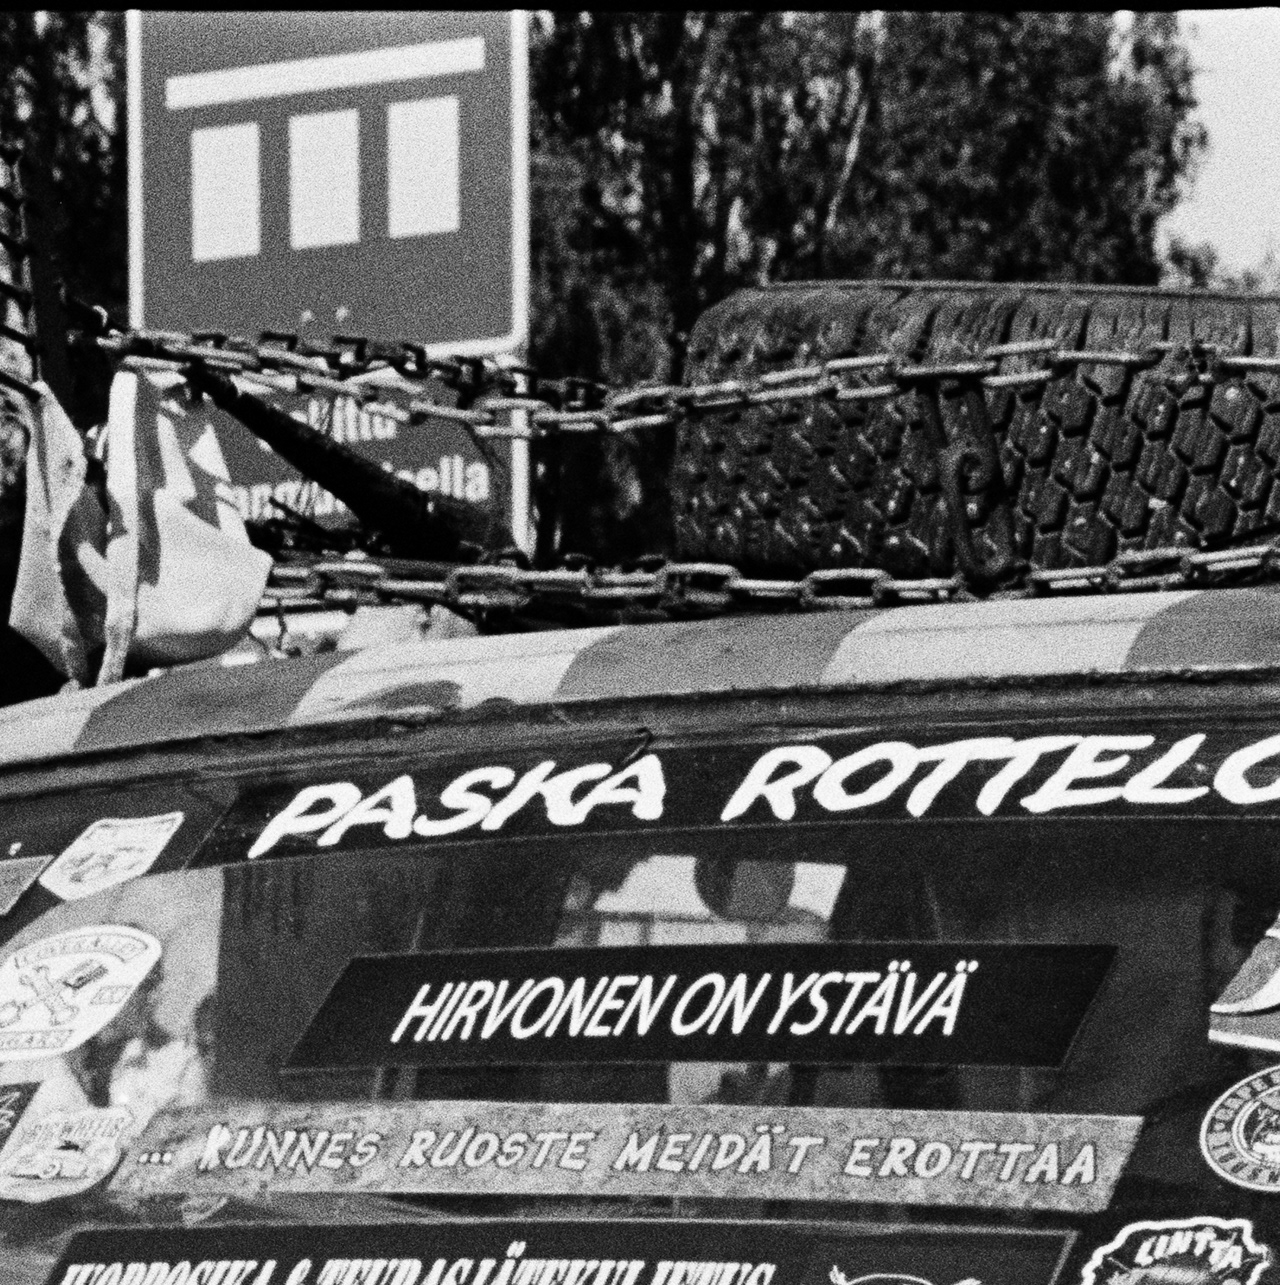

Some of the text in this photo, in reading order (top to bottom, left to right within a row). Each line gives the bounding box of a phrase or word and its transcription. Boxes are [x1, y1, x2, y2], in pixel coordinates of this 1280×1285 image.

[247, 730, 1280, 858] PASKA ROTTELO
[391, 960, 978, 1043] HIRVONEN ON YSTÄVÄ
[200, 1123, 381, 1175] KUNNES
[401, 1130, 590, 1176] RUOSTE
[614, 1119, 811, 1177] MEIDÄT
[845, 1134, 1099, 1186] EROTTAA
[1132, 1226, 1246, 1275] LINTTA
